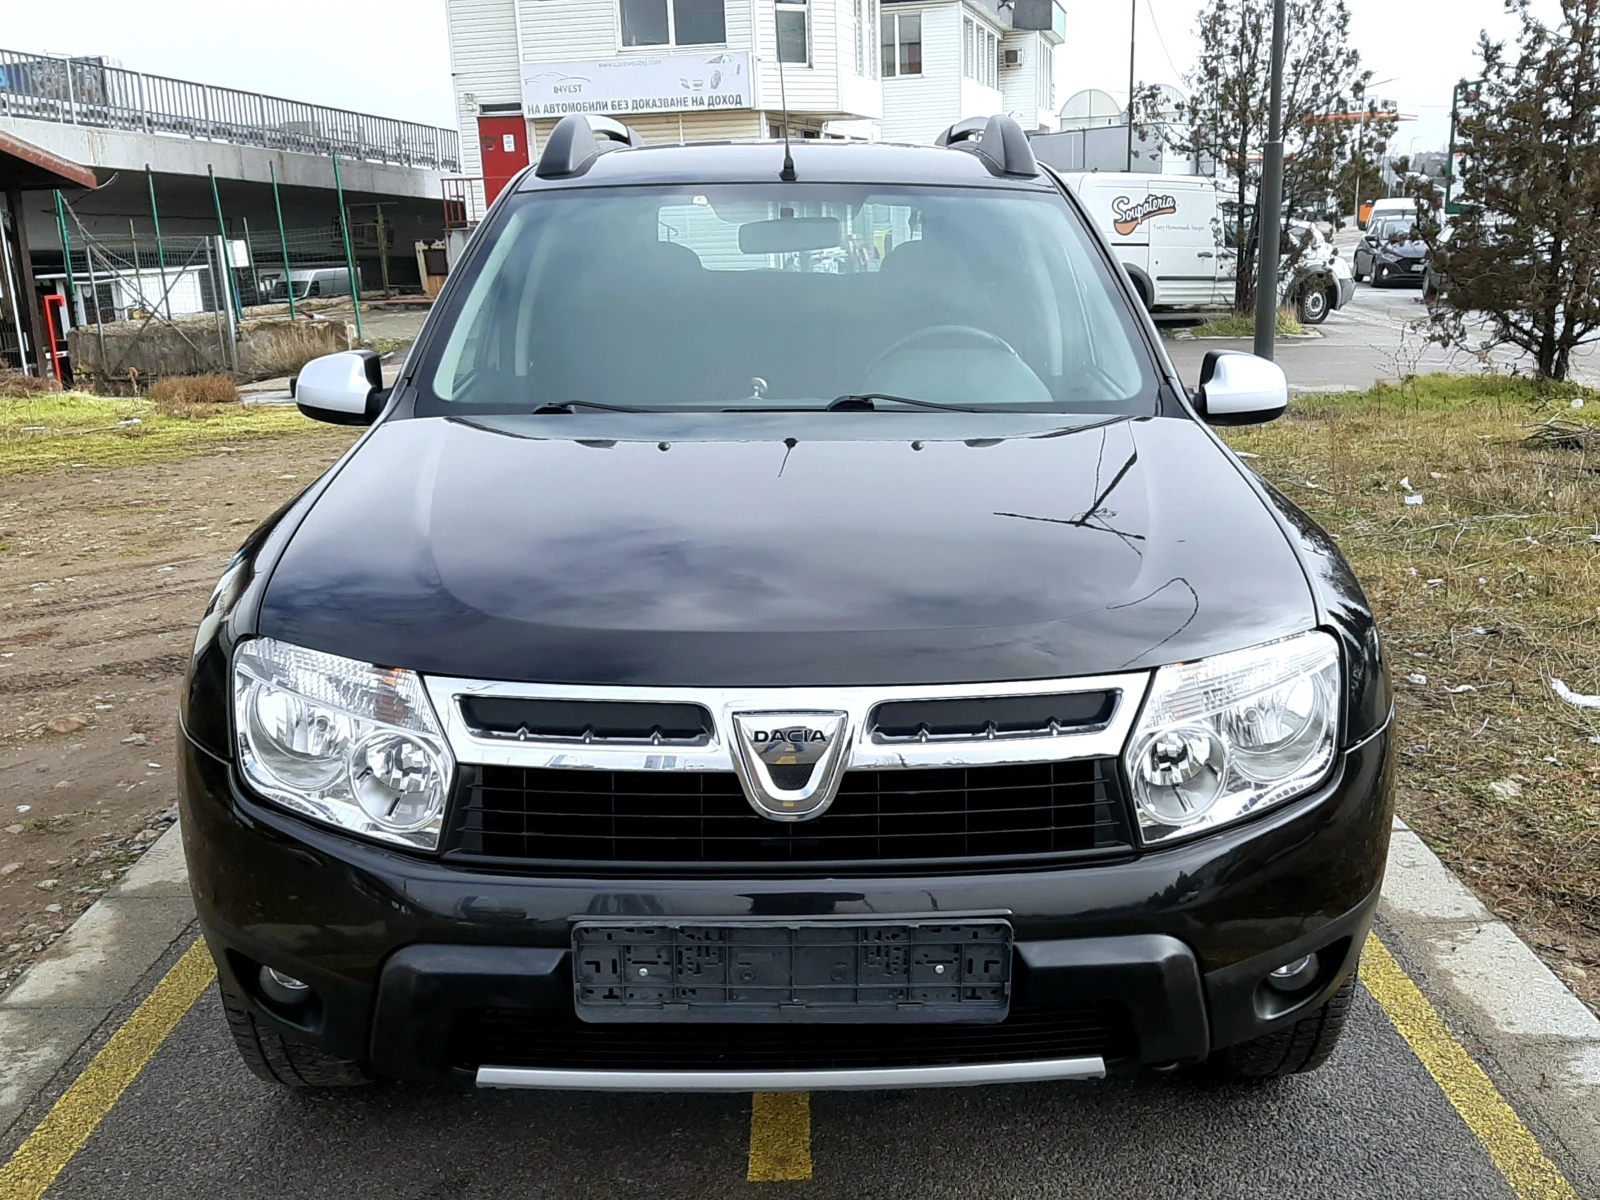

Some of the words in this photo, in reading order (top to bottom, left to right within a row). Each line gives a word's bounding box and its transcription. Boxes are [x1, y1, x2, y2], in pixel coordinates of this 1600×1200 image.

[553, 84, 582, 94] INVEST
[528, 104, 540, 115] НА
[543, 101, 609, 114] АВТОМОБИЛИ
[611, 99, 629, 110] БЕЗ
[631, 96, 689, 110] ДОКАЗВАНЕ
[691, 95, 705, 107] НА
[707, 93, 743, 107] ДОХОД
[1112, 194, 1176, 225] Soupateria
[754, 730, 826, 743] DACIA
